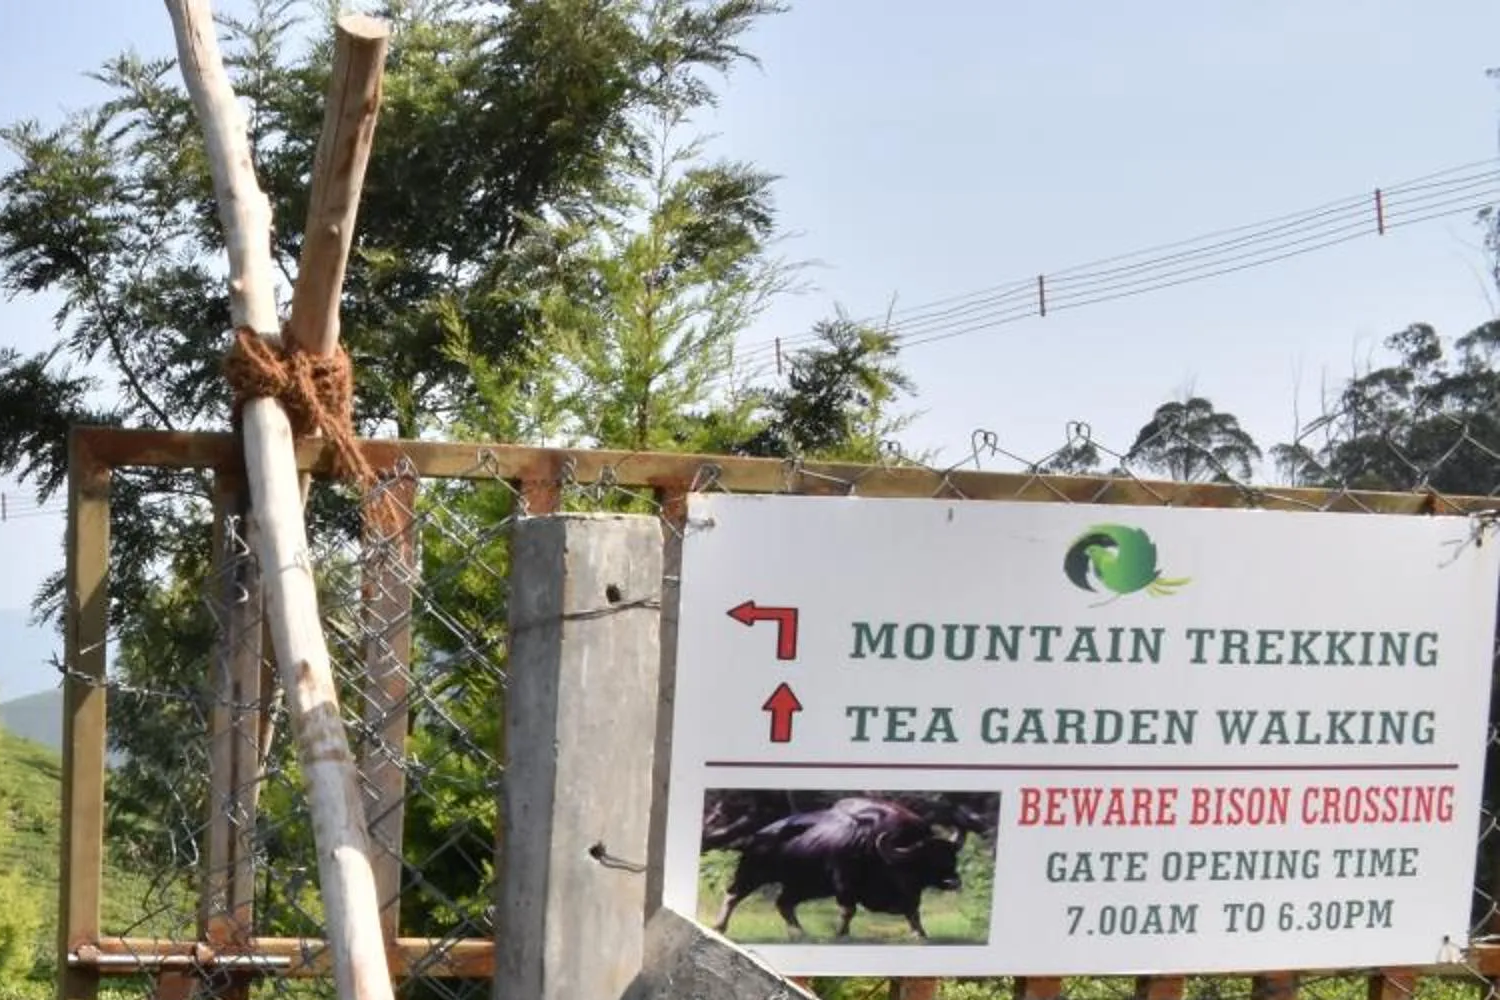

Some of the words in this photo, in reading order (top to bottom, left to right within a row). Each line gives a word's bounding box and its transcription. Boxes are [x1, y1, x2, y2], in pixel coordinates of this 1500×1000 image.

[849, 621, 1165, 664] MOUNTAIN
[1185, 628, 1438, 667] TREKKING
[845, 705, 959, 743] TEA
[980, 707, 1198, 745] GARDEN
[1216, 710, 1435, 745] WALKING
[1018, 787, 1178, 826] BEWARE
[1189, 787, 1291, 826] BISON
[1301, 785, 1455, 825] CROSSING
[1046, 851, 1149, 883] GATE
[1161, 849, 1320, 882] OPENING
[1333, 847, 1419, 878] TIME
[1067, 903, 1199, 936] 7.00AM
[1223, 902, 1265, 933] TO
[1278, 899, 1394, 932] 6.30PM
